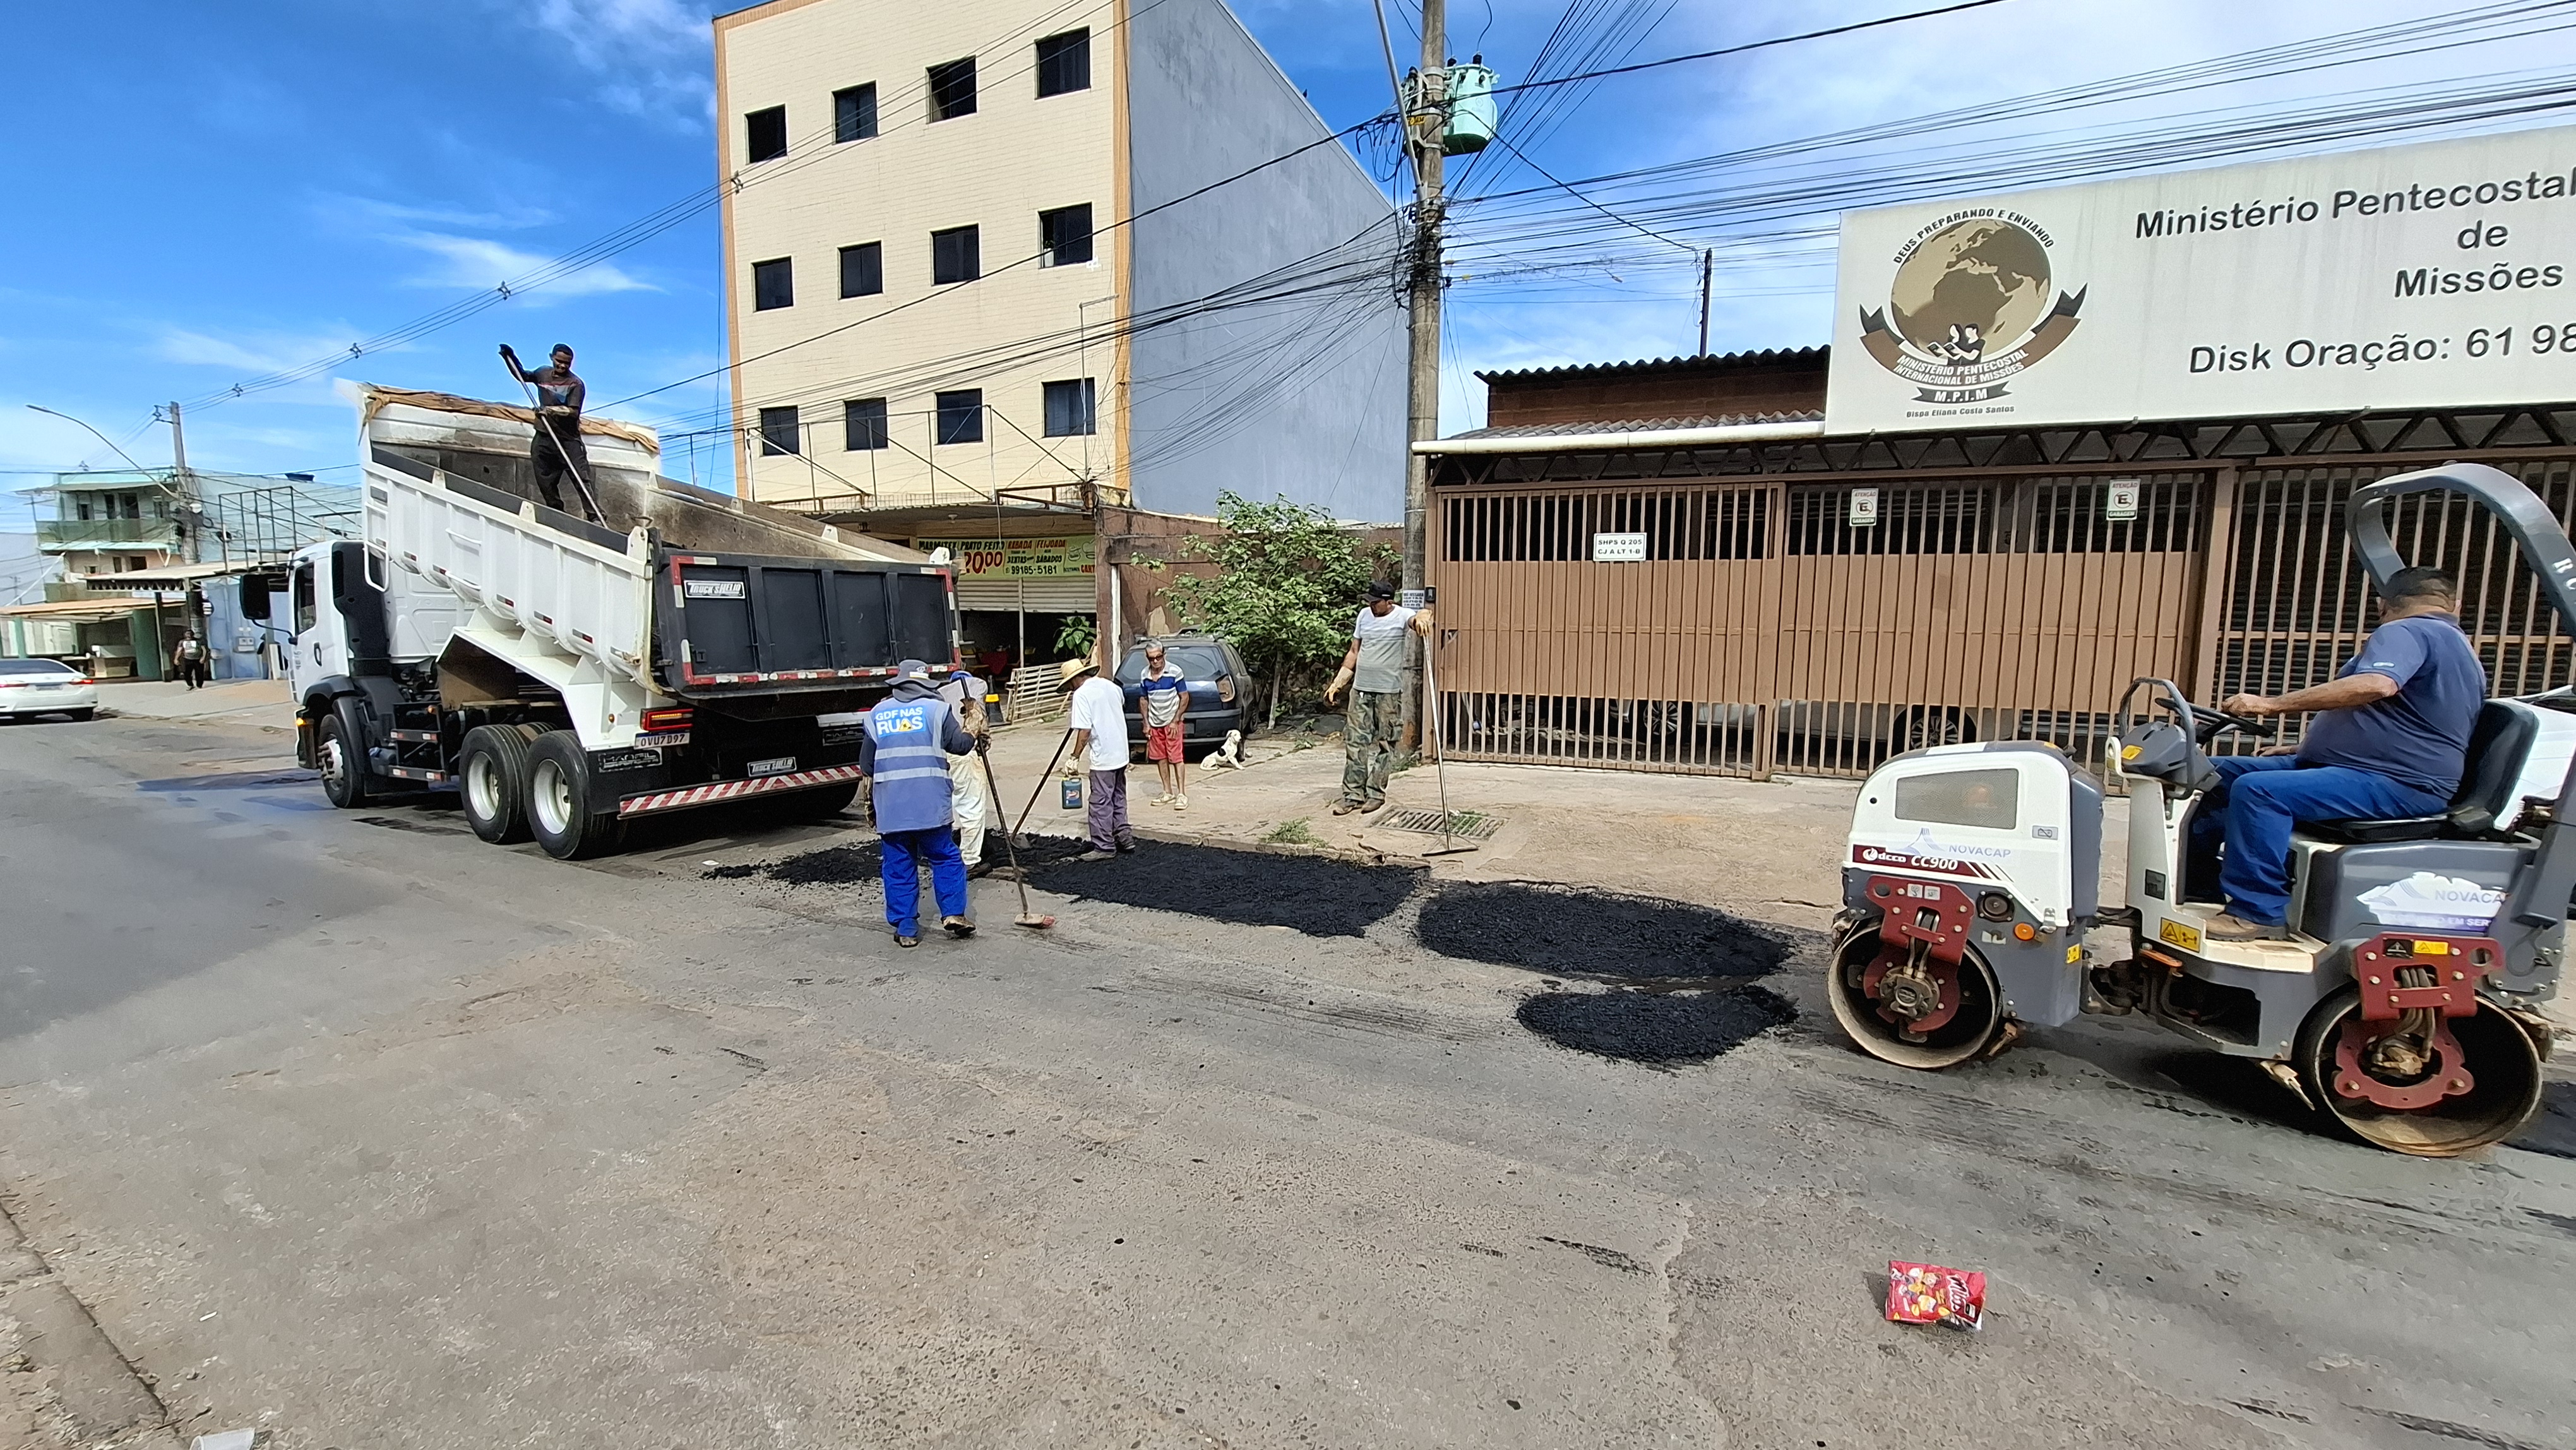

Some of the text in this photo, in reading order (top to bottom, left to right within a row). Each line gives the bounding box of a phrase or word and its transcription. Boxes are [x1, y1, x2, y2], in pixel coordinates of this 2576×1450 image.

[2135, 166, 2576, 239] Ministério Pentecostal
[1893, 208, 2054, 264] DEUS PREPARANDO E ENVIANDO
[2457, 220, 2508, 249] de
[2394, 262, 2563, 297] Missões
[2190, 323, 2576, 373] Disk Oração: 61 98
[1896, 349, 2029, 375] MINISTÉRIO PENTECOSTAL
[1894, 364, 1962, 385] INTERNACIONAL
[1980, 362, 2024, 382] MISSÕES
[1935, 388, 1988, 402] M.P.I.M
[1985, 405, 2015, 414] Santos
[960, 541, 982, 550] PRATO
[984, 541, 1005, 550] FEITO
[1008, 539, 1066, 549] RABADA FEIJOADA
[876, 707, 923, 721] GDF NAS
[876, 716, 923, 735] RUAS
[641, 734, 685, 746] OVU7D97
[1949, 845, 2011, 858] NOVACAP
[1911, 856, 1958, 870] CC900
